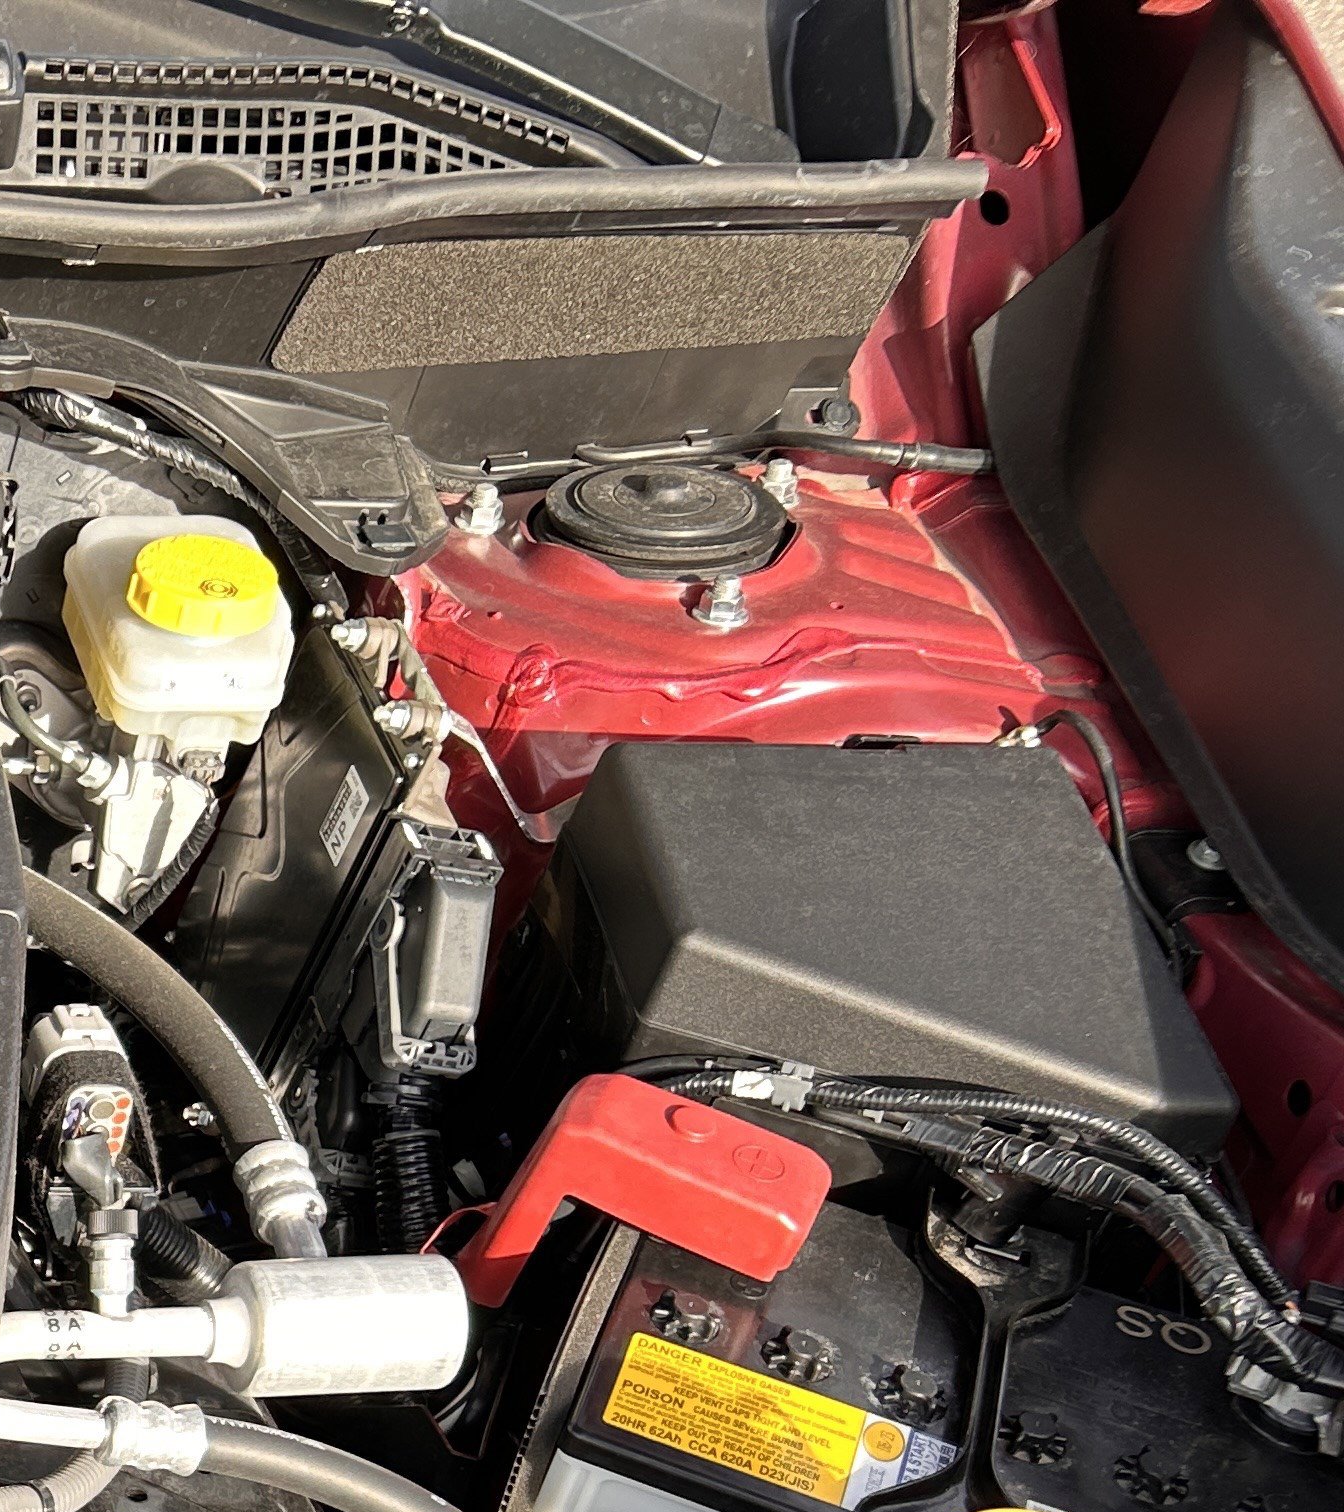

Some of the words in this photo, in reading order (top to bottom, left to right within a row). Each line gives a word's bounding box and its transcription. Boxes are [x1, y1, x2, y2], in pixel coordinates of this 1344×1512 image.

[637, 1337, 703, 1367] DANGER
[707, 1362, 757, 1386] EXPLOSIVE
[759, 1380, 792, 1397] GASES
[621, 1379, 686, 1409] POISON
[693, 1405, 732, 1425] CAUSES
[732, 1418, 769, 1438] SEVERE
[771, 1433, 804, 1450] BURNS
[673, 1385, 699, 1400] KEEP
[700, 1394, 724, 1408] VENT
[725, 1404, 750, 1419] CAPS
[753, 1413, 780, 1429] TIGHT
[780, 1424, 801, 1437] AND
[801, 1432, 831, 1449] LEVEL
[610, 1412, 648, 1432] 20HR
[648, 1425, 682, 1446] 62Ah
[688, 1440, 718, 1458] CCA
[720, 1451, 754, 1471] 620A
[758, 1464, 816, 1493] D23(JIS)
[661, 1418, 687, 1432] KEEP
[687, 1427, 707, 1441] OUT
[708, 1434, 722, 1445] OF
[723, 1440, 756, 1459] REACH
[757, 1452, 772, 1463] OF
[772, 1457, 821, 1482] CHILDREN
